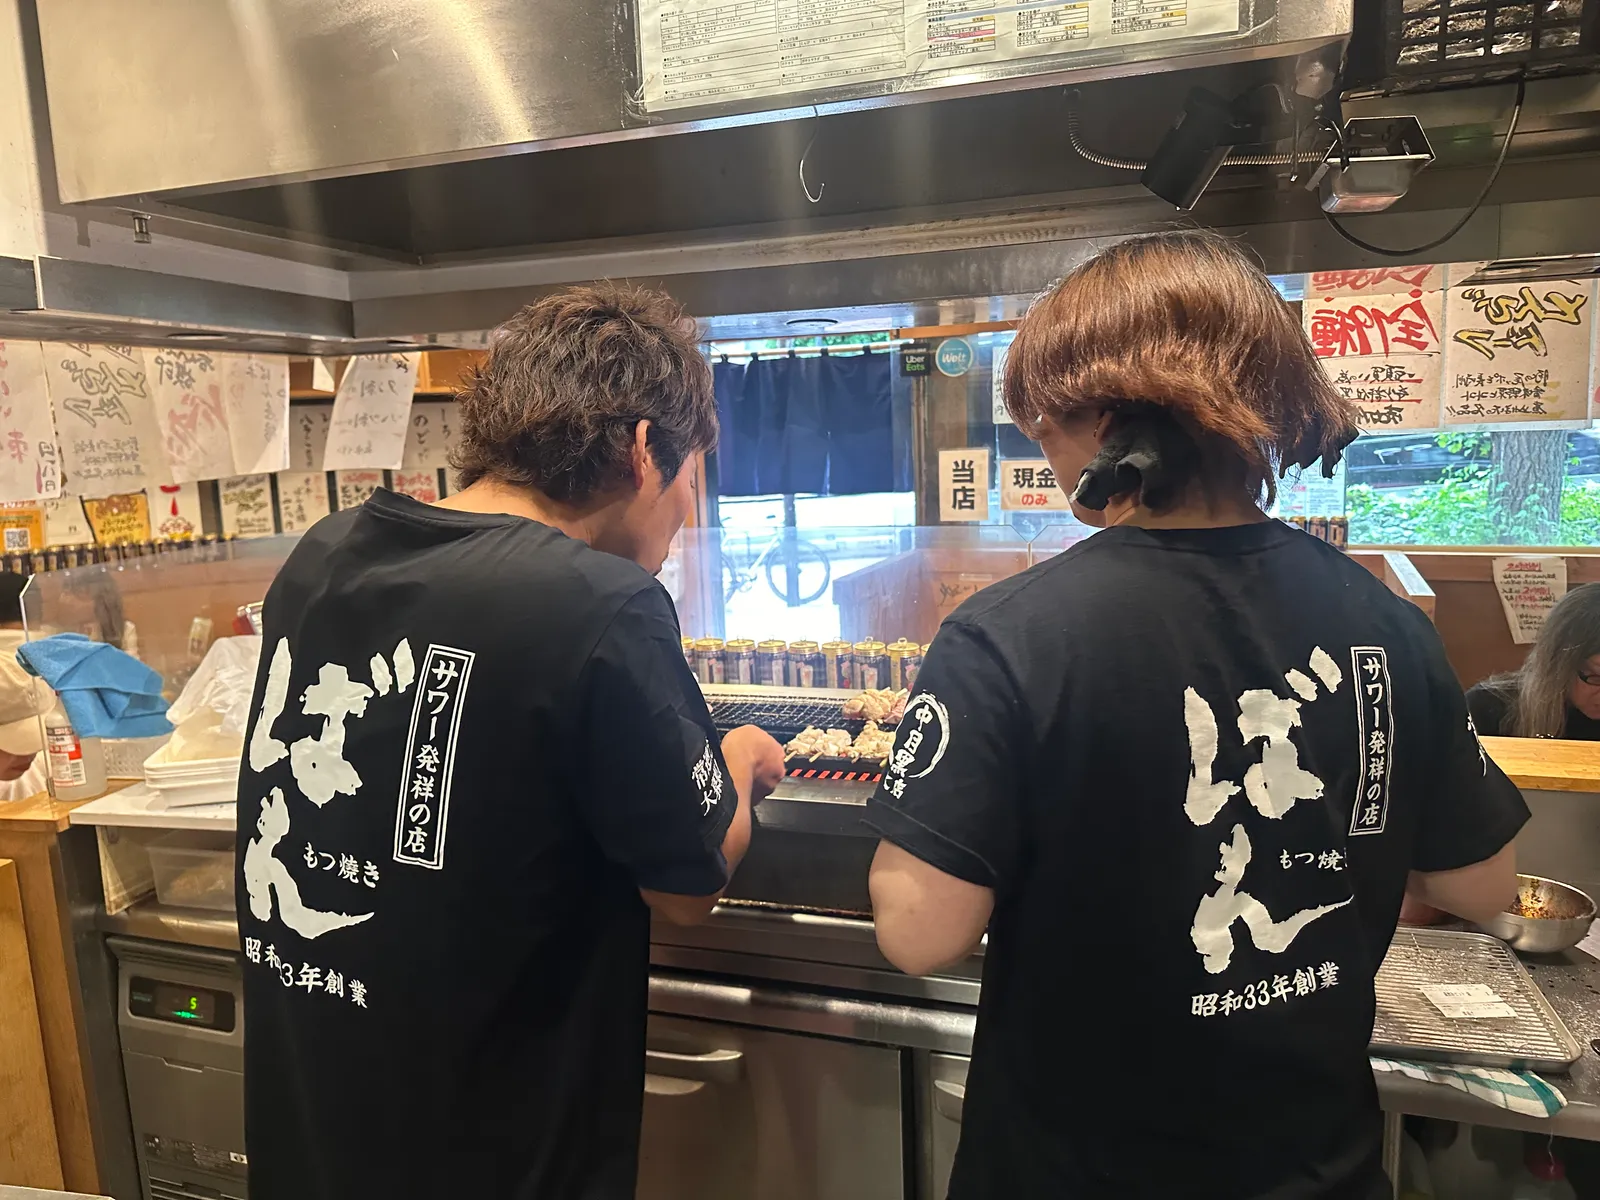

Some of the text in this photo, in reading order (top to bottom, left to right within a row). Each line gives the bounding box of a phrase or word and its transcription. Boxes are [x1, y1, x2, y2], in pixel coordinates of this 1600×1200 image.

[905, 355, 925, 363] Uber
[906, 363, 925, 372] Eats
[942, 352, 966, 363] Wolt
[952, 459, 976, 511] 当店
[1013, 467, 1057, 489] 現金
[1021, 493, 1048, 506] のみ
[404, 660, 459, 854] サワー発祥の店
[890, 704, 933, 778] 中目黒
[1359, 657, 1386, 826] サワー発祥の店
[1279, 847, 1348, 872] もつ焼
[245, 937, 368, 1009] 昭和3年創業
[1191, 961, 1340, 1018] 昭和33年創業
